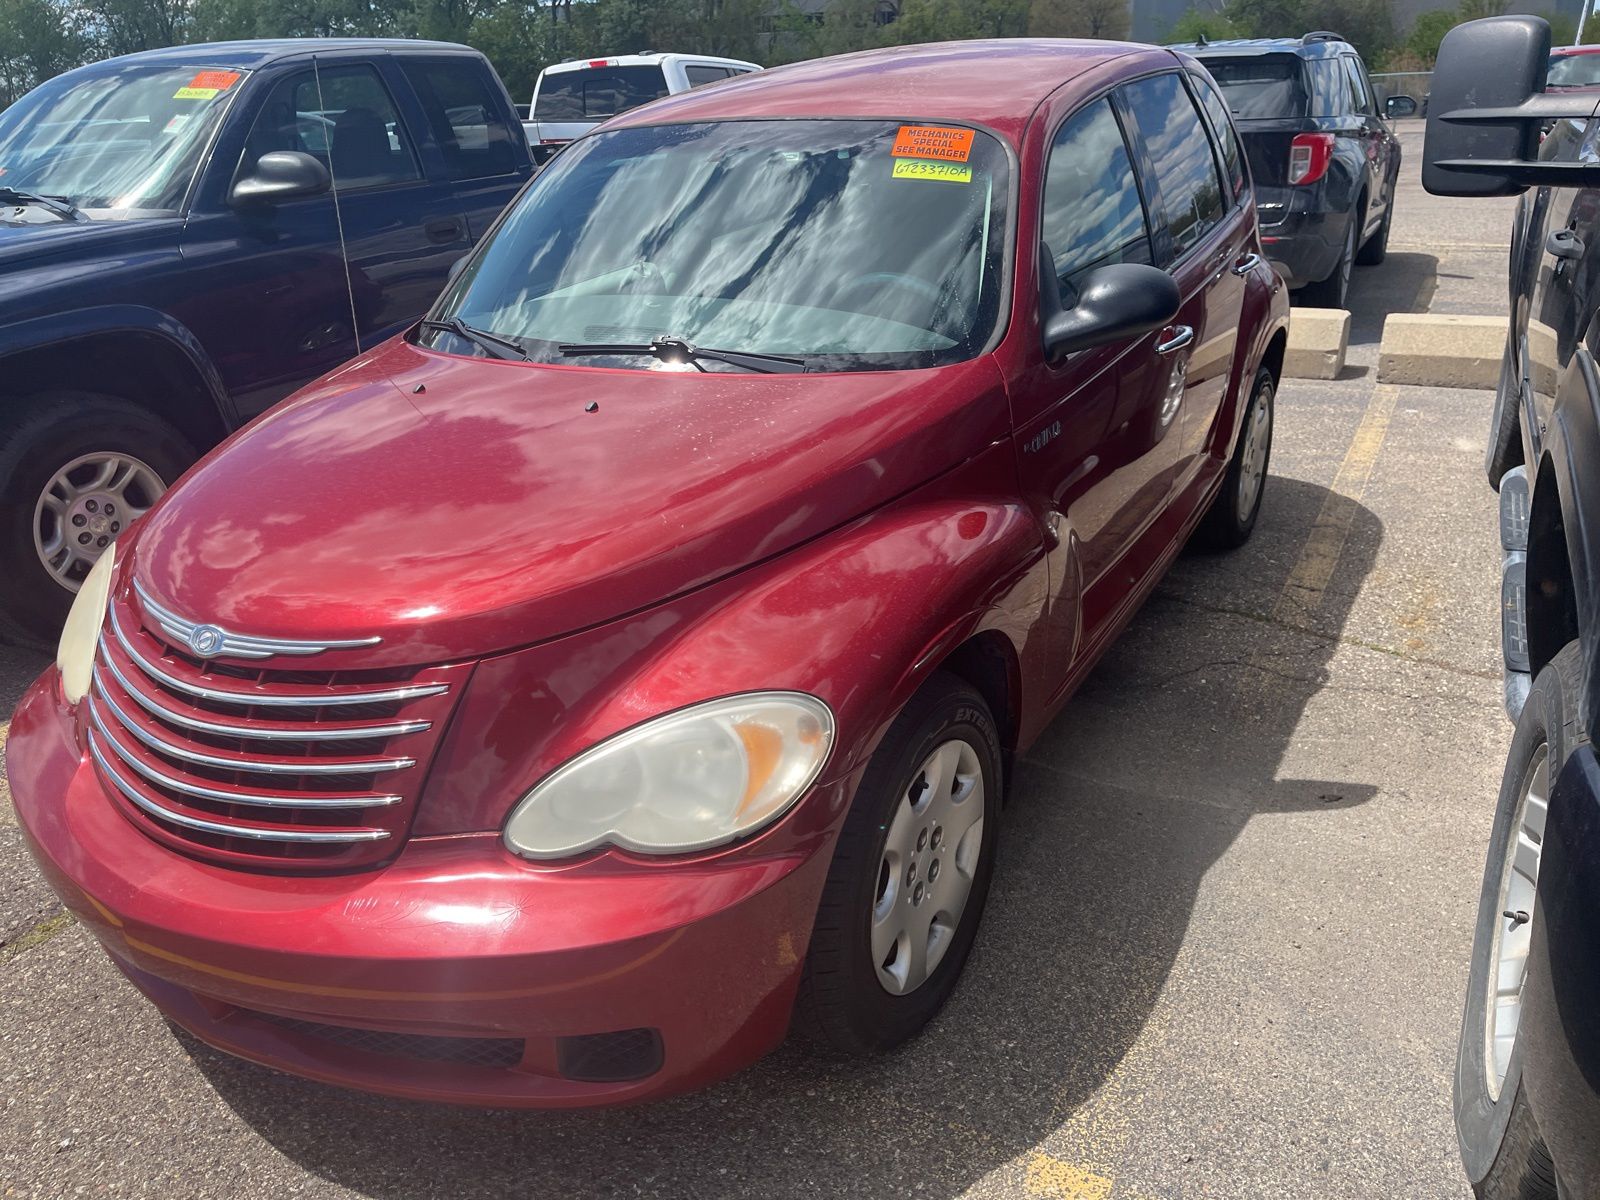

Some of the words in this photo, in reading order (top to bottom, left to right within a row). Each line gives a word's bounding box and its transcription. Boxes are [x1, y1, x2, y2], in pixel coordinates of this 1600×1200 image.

[908, 129, 965, 140] MECHANICS
[913, 138, 953, 148] SPECIAL
[896, 145, 915, 153] SEE
[916, 147, 966, 159] MANAGER
